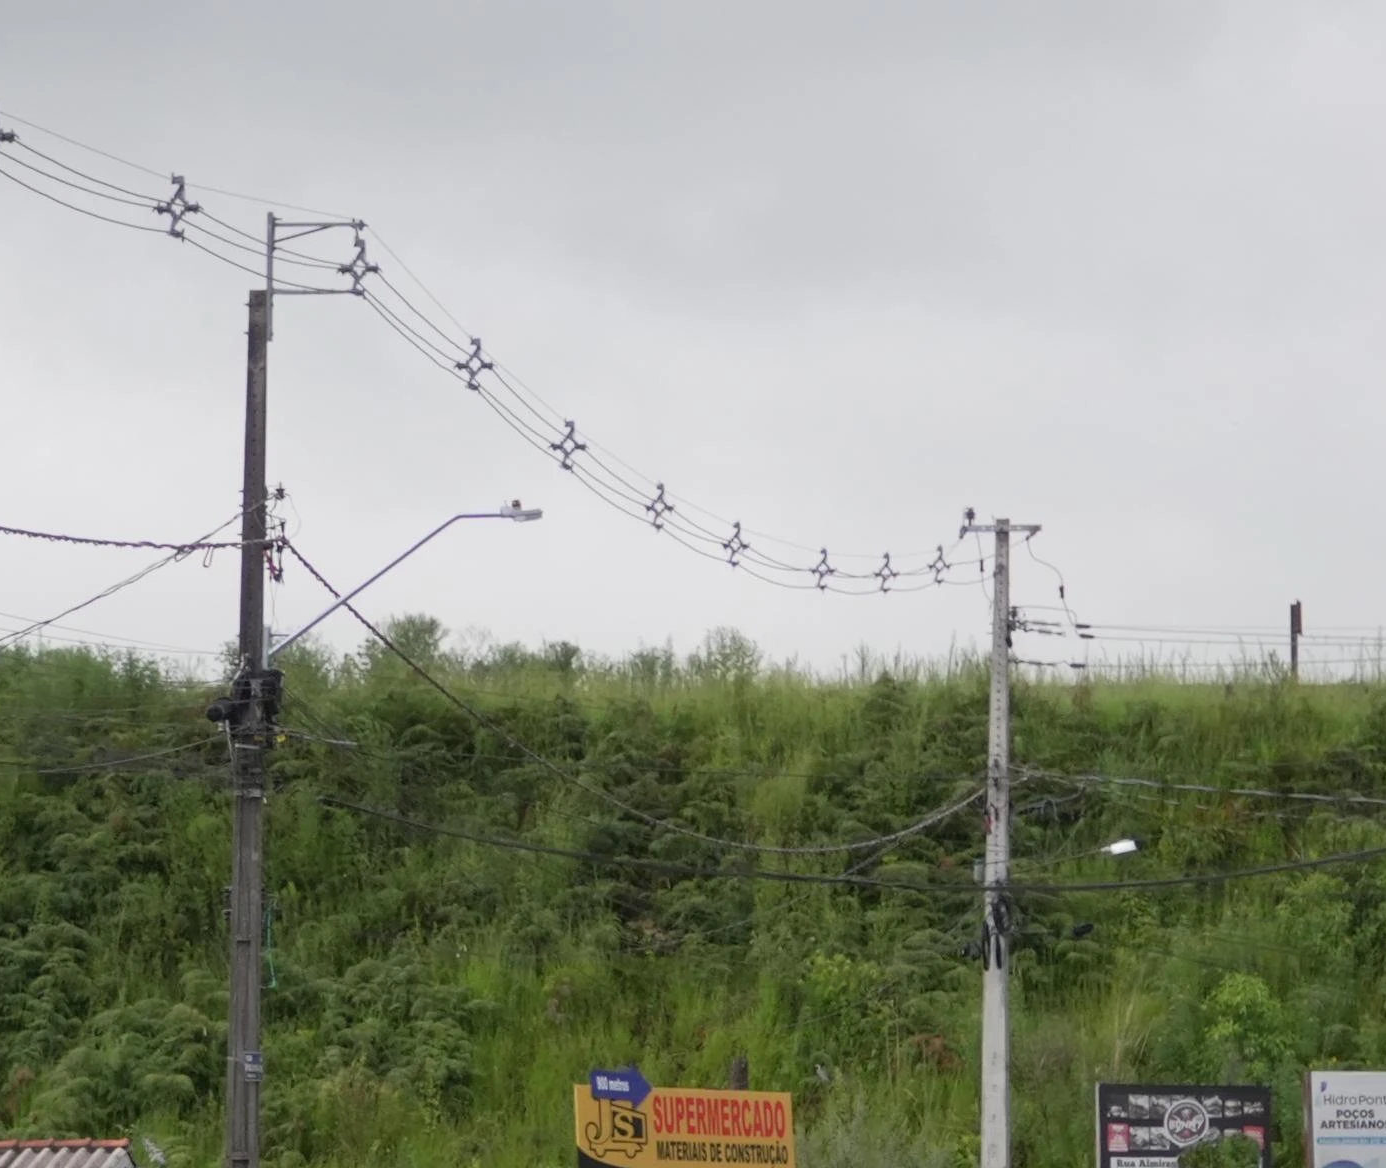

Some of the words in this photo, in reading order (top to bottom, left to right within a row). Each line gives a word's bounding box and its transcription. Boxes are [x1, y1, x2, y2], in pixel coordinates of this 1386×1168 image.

[653, 1095, 786, 1138] SUPERMERCADO
[1336, 1109, 1375, 1120] POÇOS
[656, 1140, 707, 1161] MATERIAIS
[709, 1142, 723, 1162] DE
[724, 1141, 789, 1168] CONSTRUÇÃO
[1116, 1158, 1136, 1168] Rua
